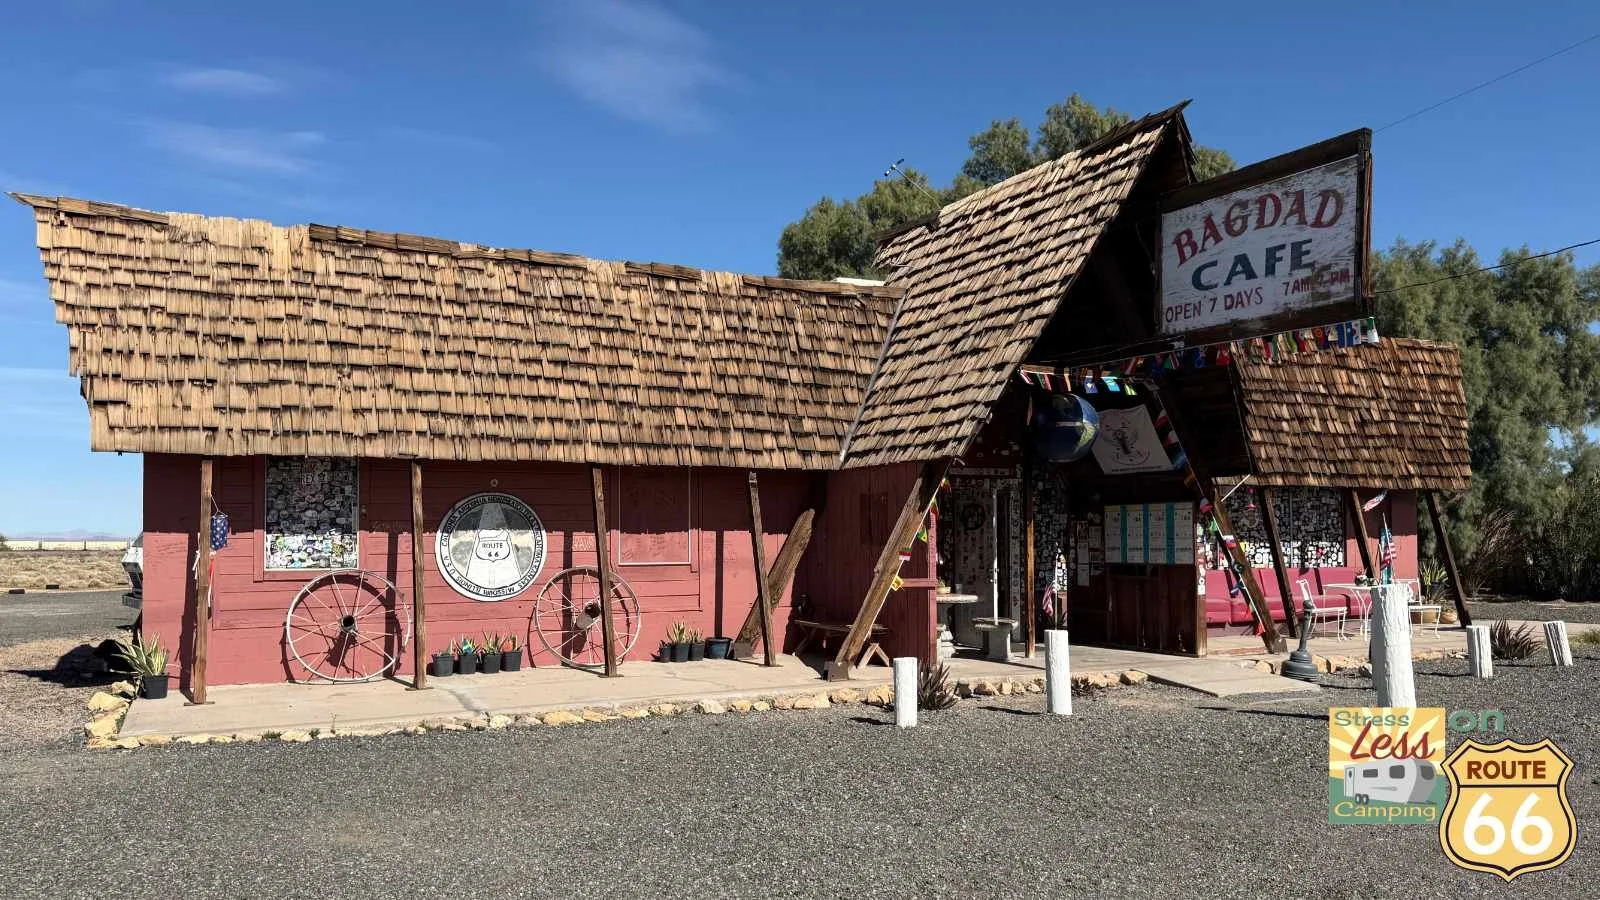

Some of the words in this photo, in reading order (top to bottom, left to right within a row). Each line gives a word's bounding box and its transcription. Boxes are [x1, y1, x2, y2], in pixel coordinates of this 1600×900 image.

[1172, 188, 1345, 268] BAGDAD
[1191, 238, 1316, 292] CAFE
[1165, 300, 1201, 323] OPEN
[1208, 297, 1218, 313] 7
[1223, 286, 1264, 311] DAYS
